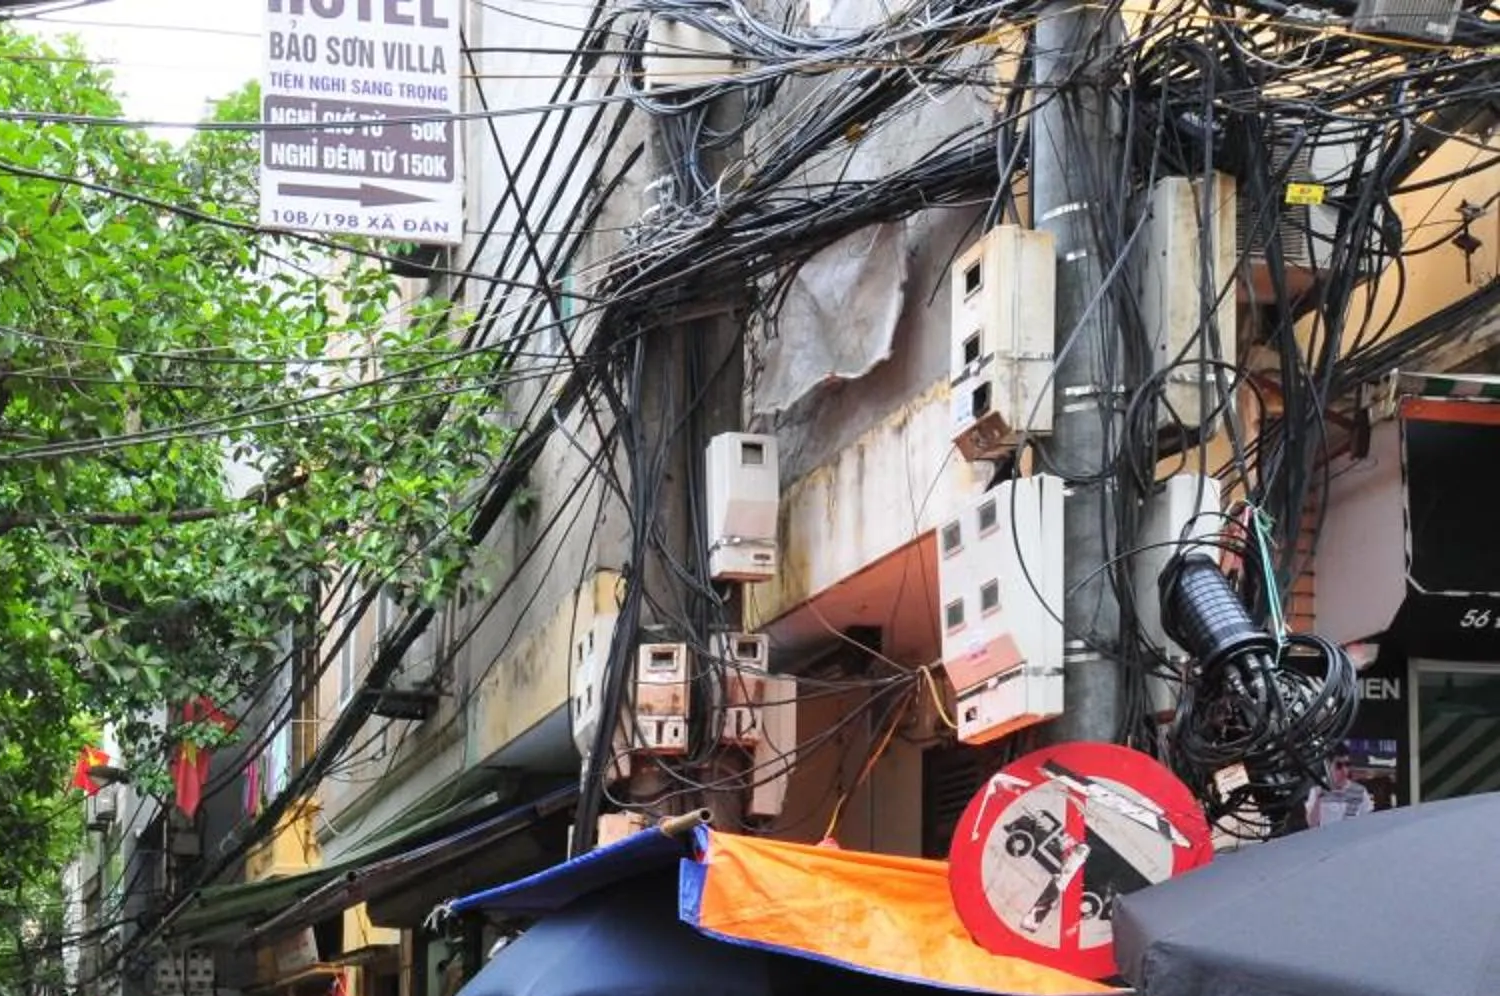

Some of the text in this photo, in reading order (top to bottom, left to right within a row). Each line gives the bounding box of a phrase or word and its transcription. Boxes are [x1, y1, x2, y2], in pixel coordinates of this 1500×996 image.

[326, 35, 375, 69] SƠN
[383, 42, 447, 74] VILLA
[352, 79, 393, 97] SANG
[411, 120, 448, 143] 50K
[400, 153, 448, 177] 150K
[1460, 609, 1491, 628] 56
